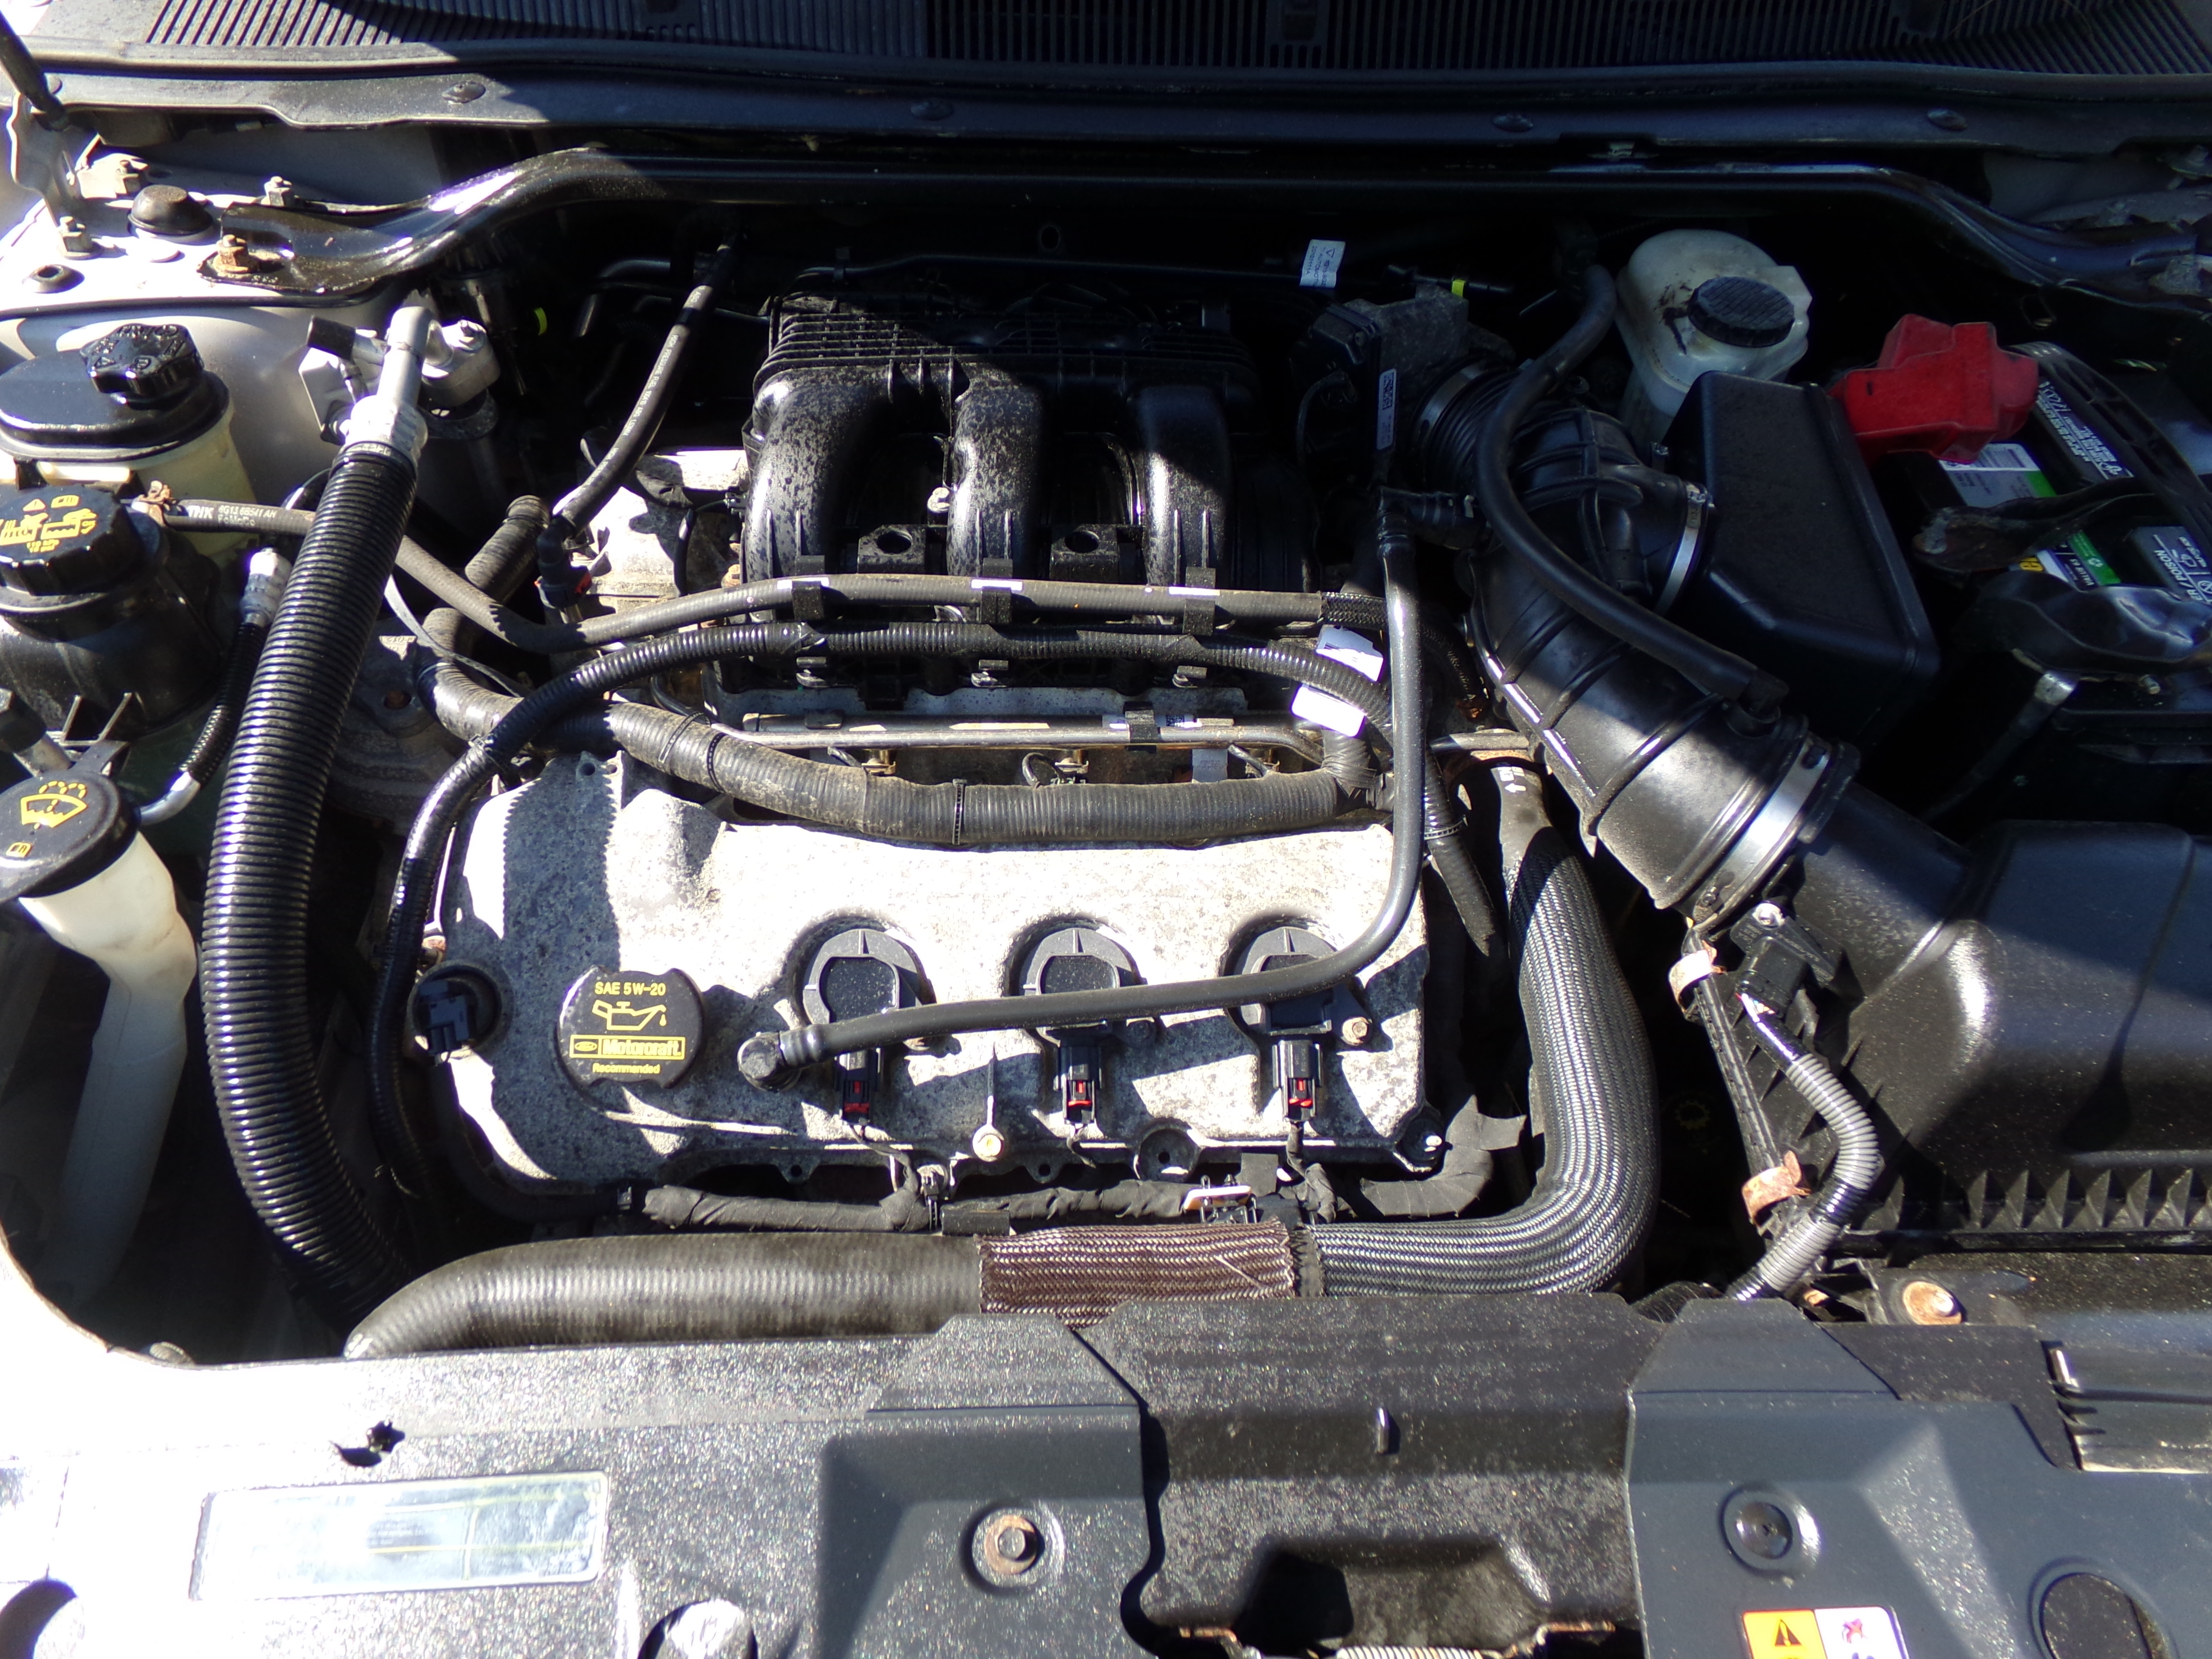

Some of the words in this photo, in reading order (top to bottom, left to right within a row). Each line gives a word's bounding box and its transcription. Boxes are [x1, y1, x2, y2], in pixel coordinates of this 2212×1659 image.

[2154, 550, 2188, 580] POISON
[594, 982, 621, 995] SAE
[624, 982, 666, 996] 5W-20
[592, 1062, 661, 1074] Recommended
